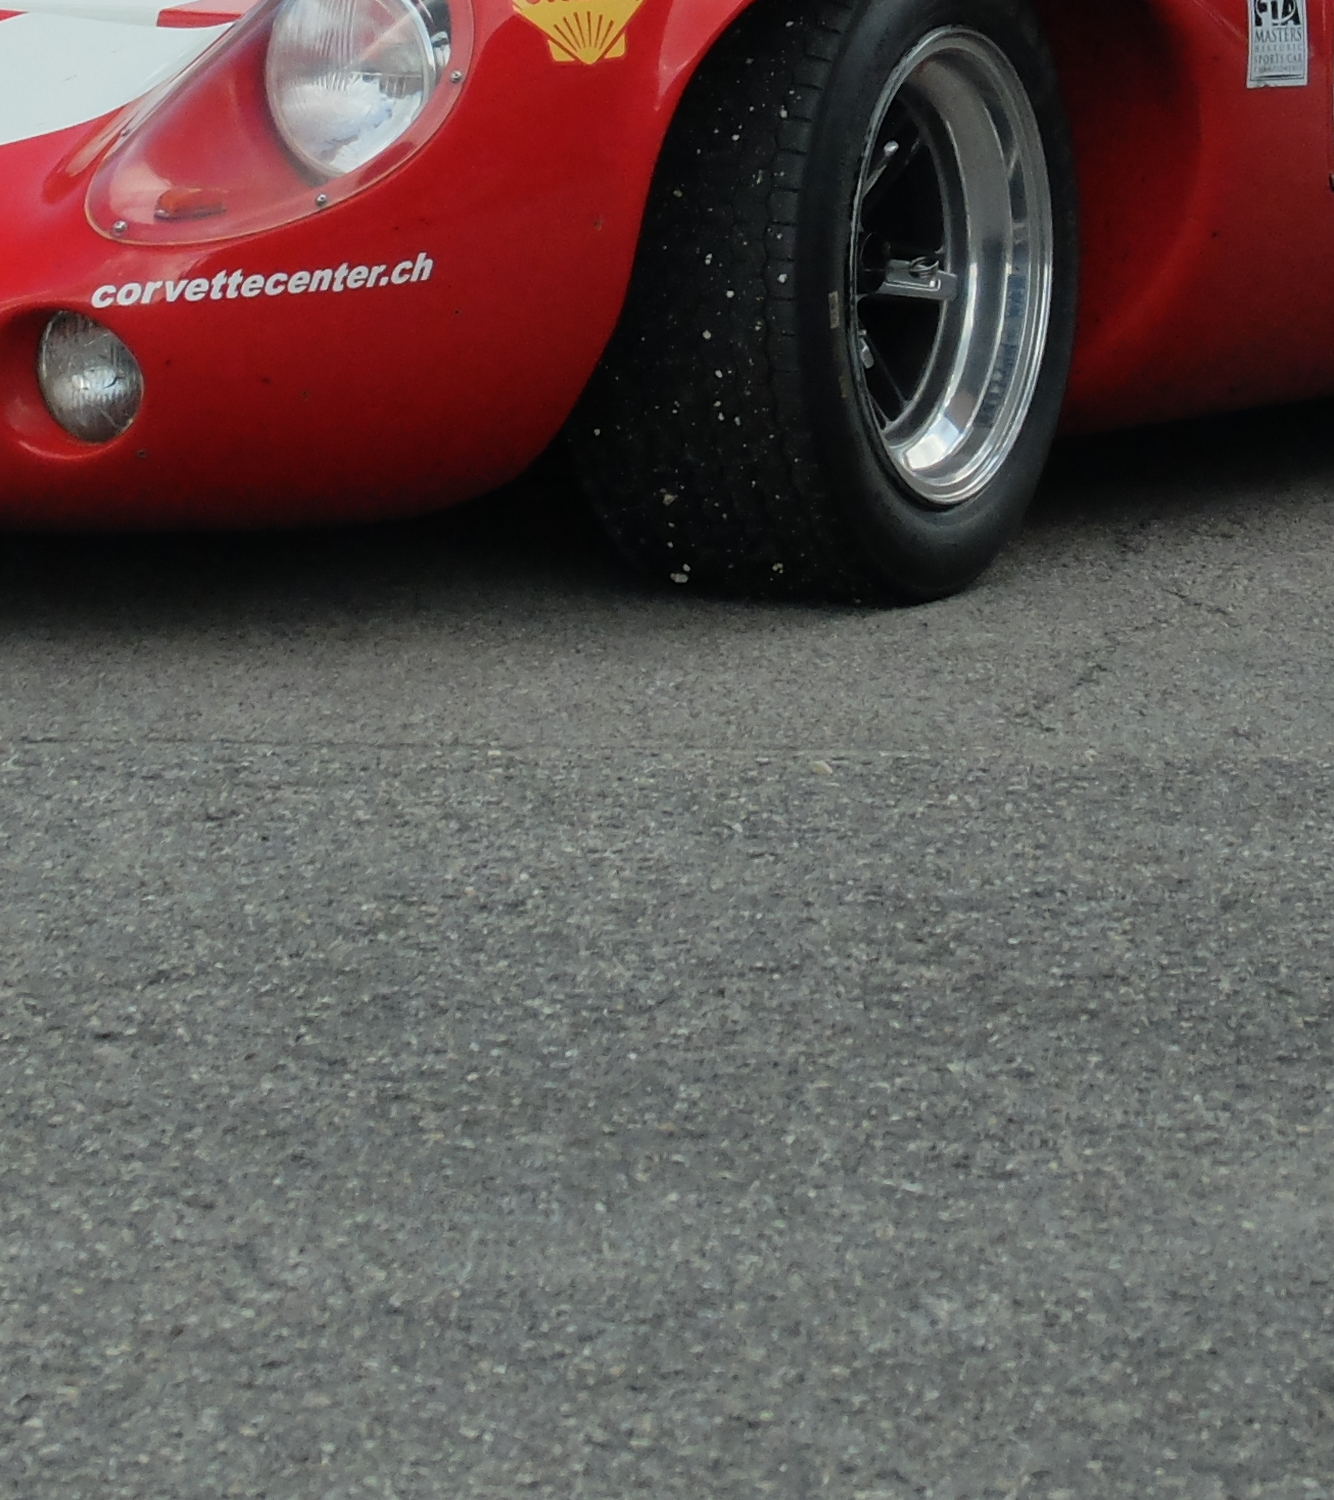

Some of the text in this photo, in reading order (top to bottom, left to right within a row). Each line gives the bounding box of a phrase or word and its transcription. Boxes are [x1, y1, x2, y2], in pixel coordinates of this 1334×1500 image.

[1254, 27, 1302, 43] MASTERS
[1254, 53, 1303, 64] SPORTS CAR
[91, 252, 434, 309] corvettecenter.ch
